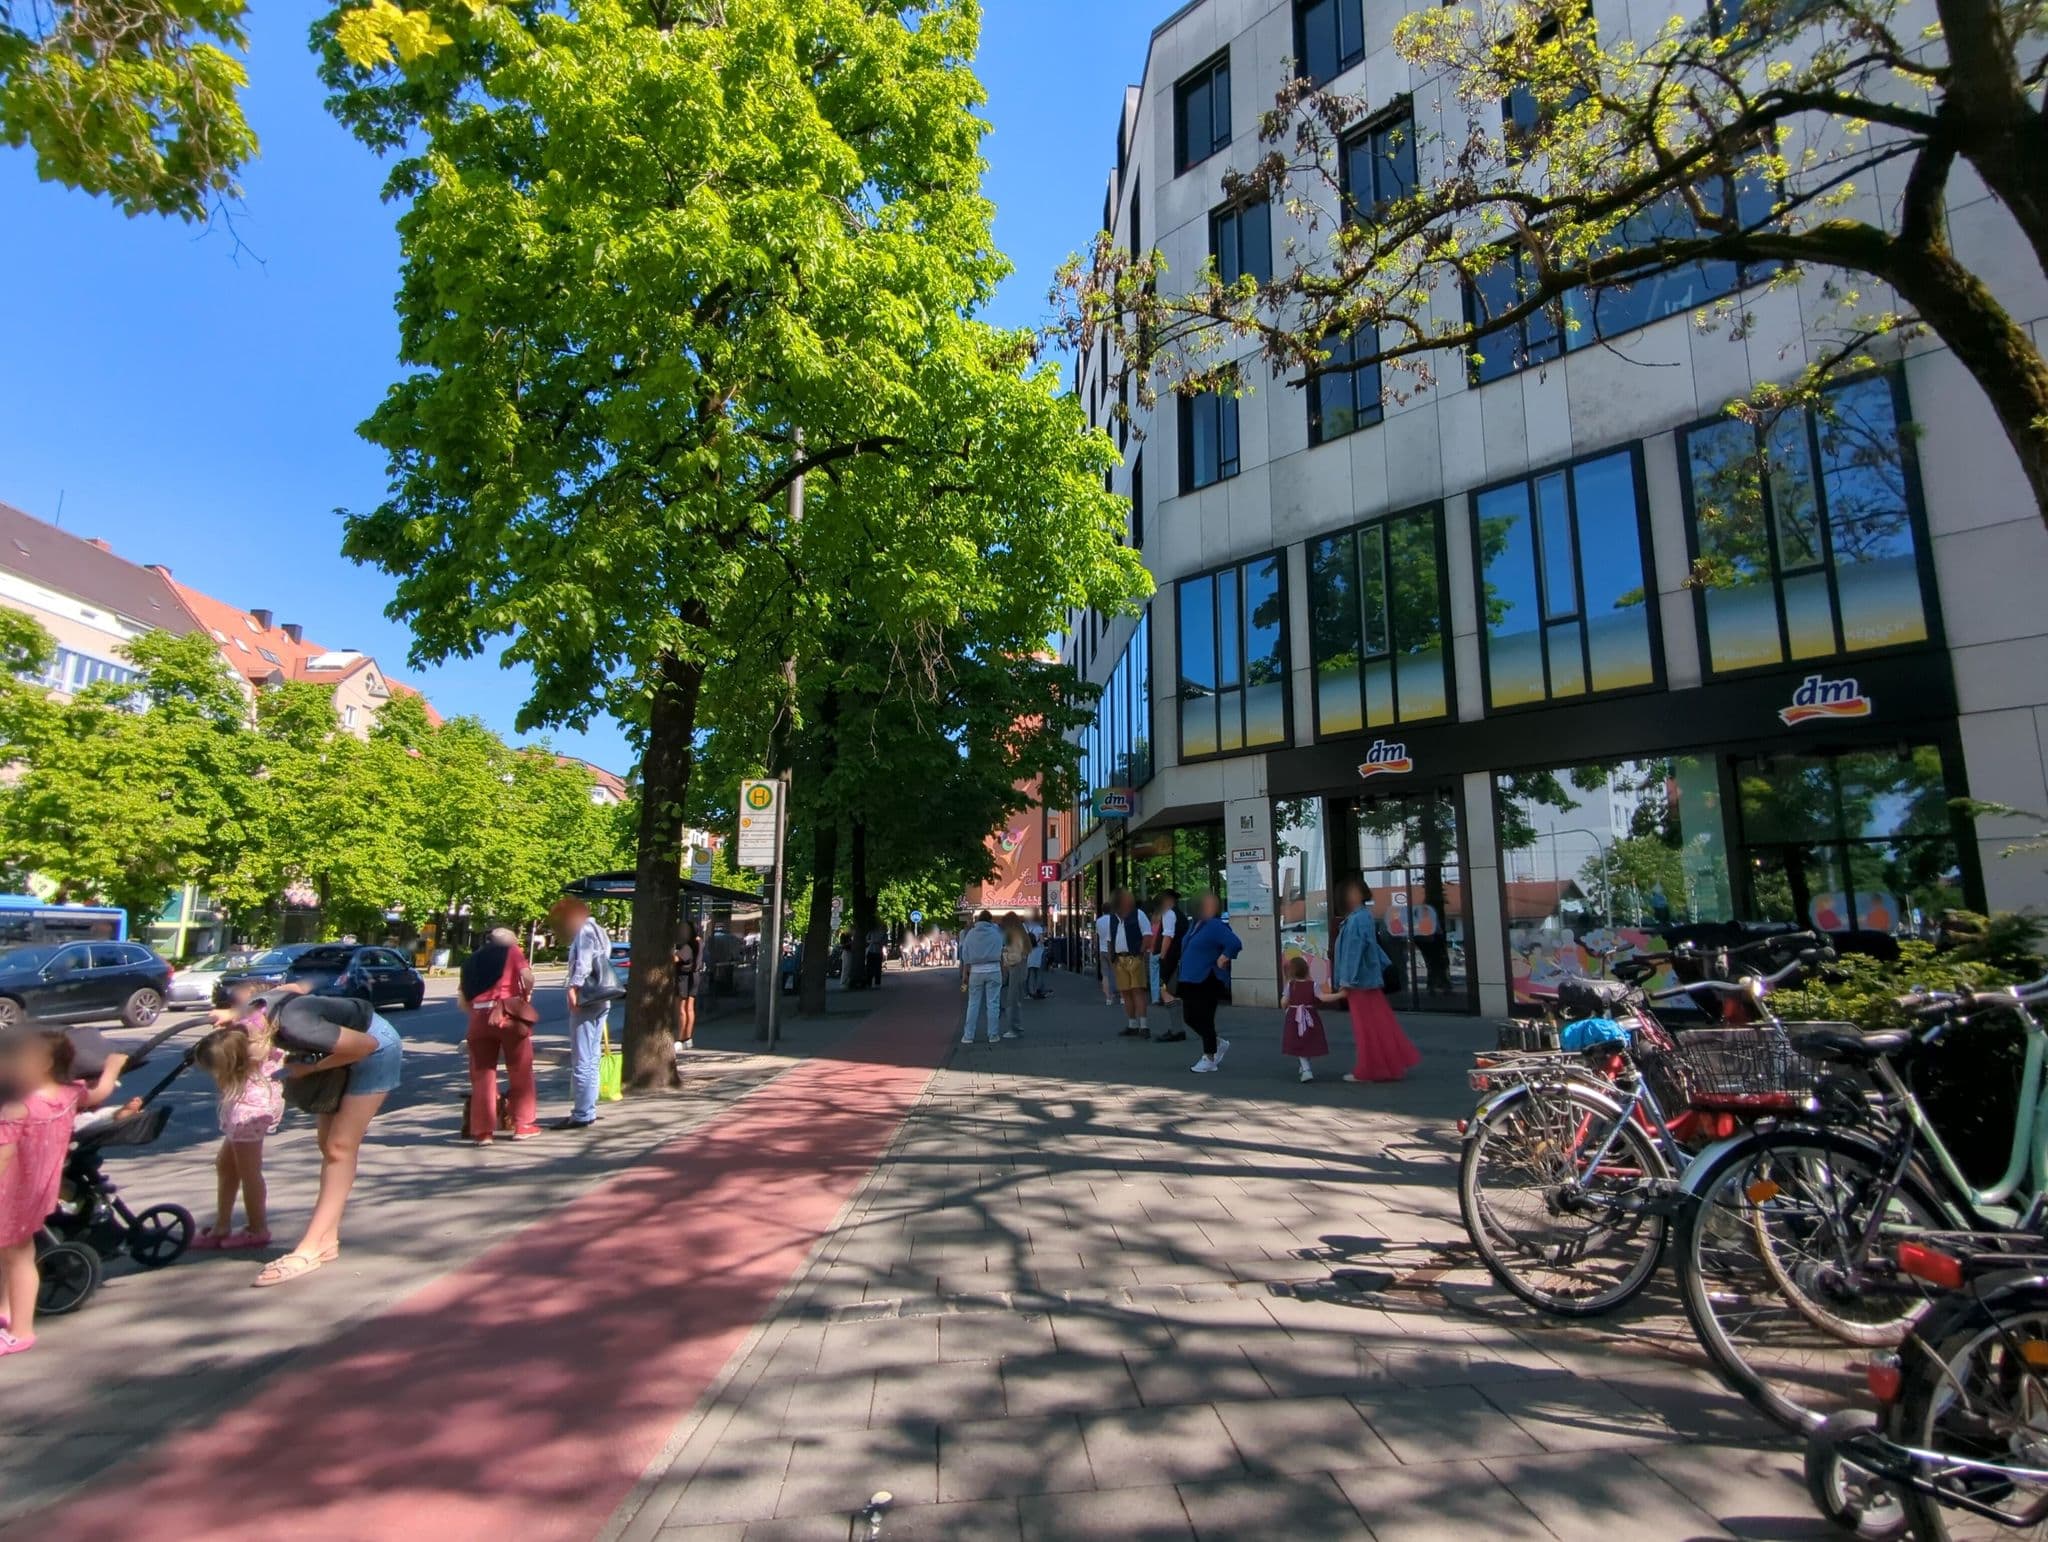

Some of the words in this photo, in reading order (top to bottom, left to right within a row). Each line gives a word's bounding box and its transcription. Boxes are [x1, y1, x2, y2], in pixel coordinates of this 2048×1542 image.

[1796, 678, 1855, 706] dm
[1368, 741, 1403, 763] dm
[754, 790, 765, 804] H
[1104, 792, 1125, 805] dm
[1041, 865, 1053, 879] T
